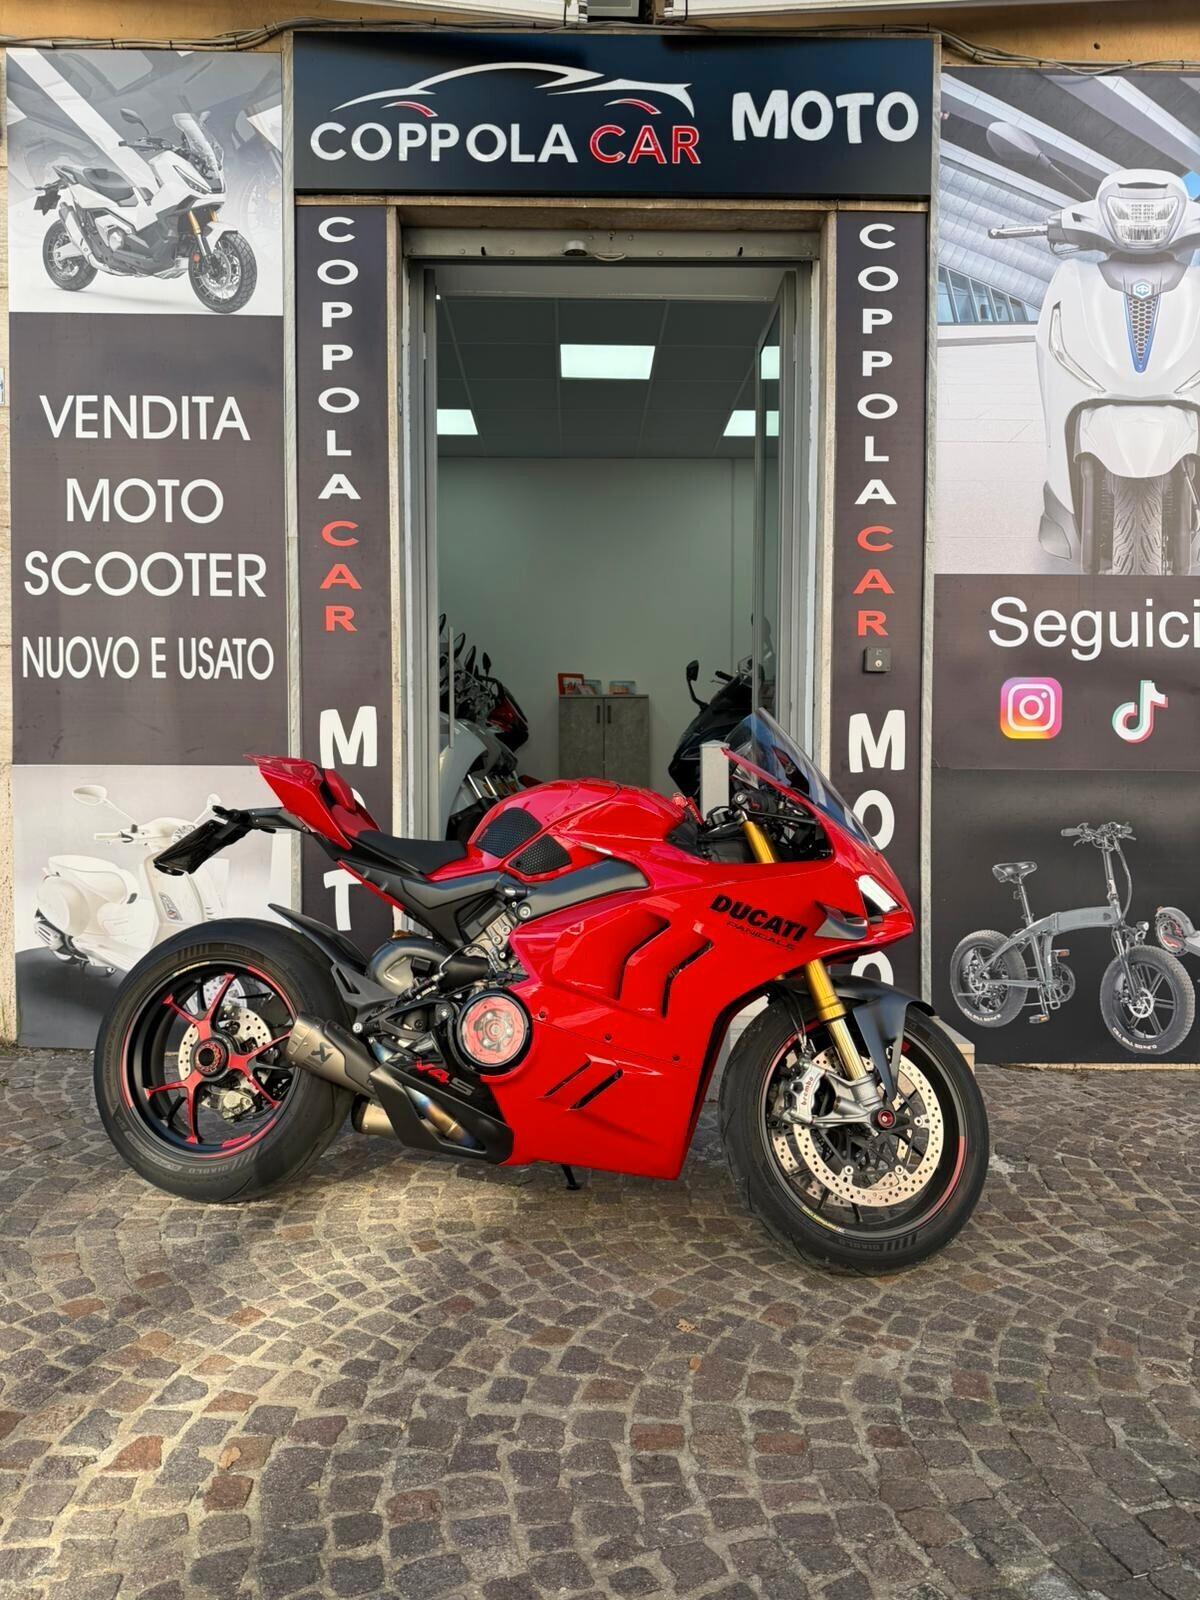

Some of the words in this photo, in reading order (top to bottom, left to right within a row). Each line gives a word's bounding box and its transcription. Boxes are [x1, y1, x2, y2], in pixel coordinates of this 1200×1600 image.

[310, 121, 578, 164] COPPOLA
[589, 125, 701, 165] CAR
[732, 89, 919, 145] MOTO
[317, 216, 362, 500] COPPOLA
[856, 223, 899, 505] COPPOLA
[39, 394, 251, 441] VENDITA
[66, 477, 224, 524] MOTO
[23, 550, 267, 598] SCOOTER
[320, 520, 362, 633] CAR
[853, 525, 895, 637] CAR
[988, 596, 1200, 662] Seguici
[22, 635, 140, 680] NUOVO
[151, 636, 167, 679] E
[178, 636, 275, 681] USATO
[709, 894, 808, 942] DUCATI
[801, 1076, 814, 1106] brembo
